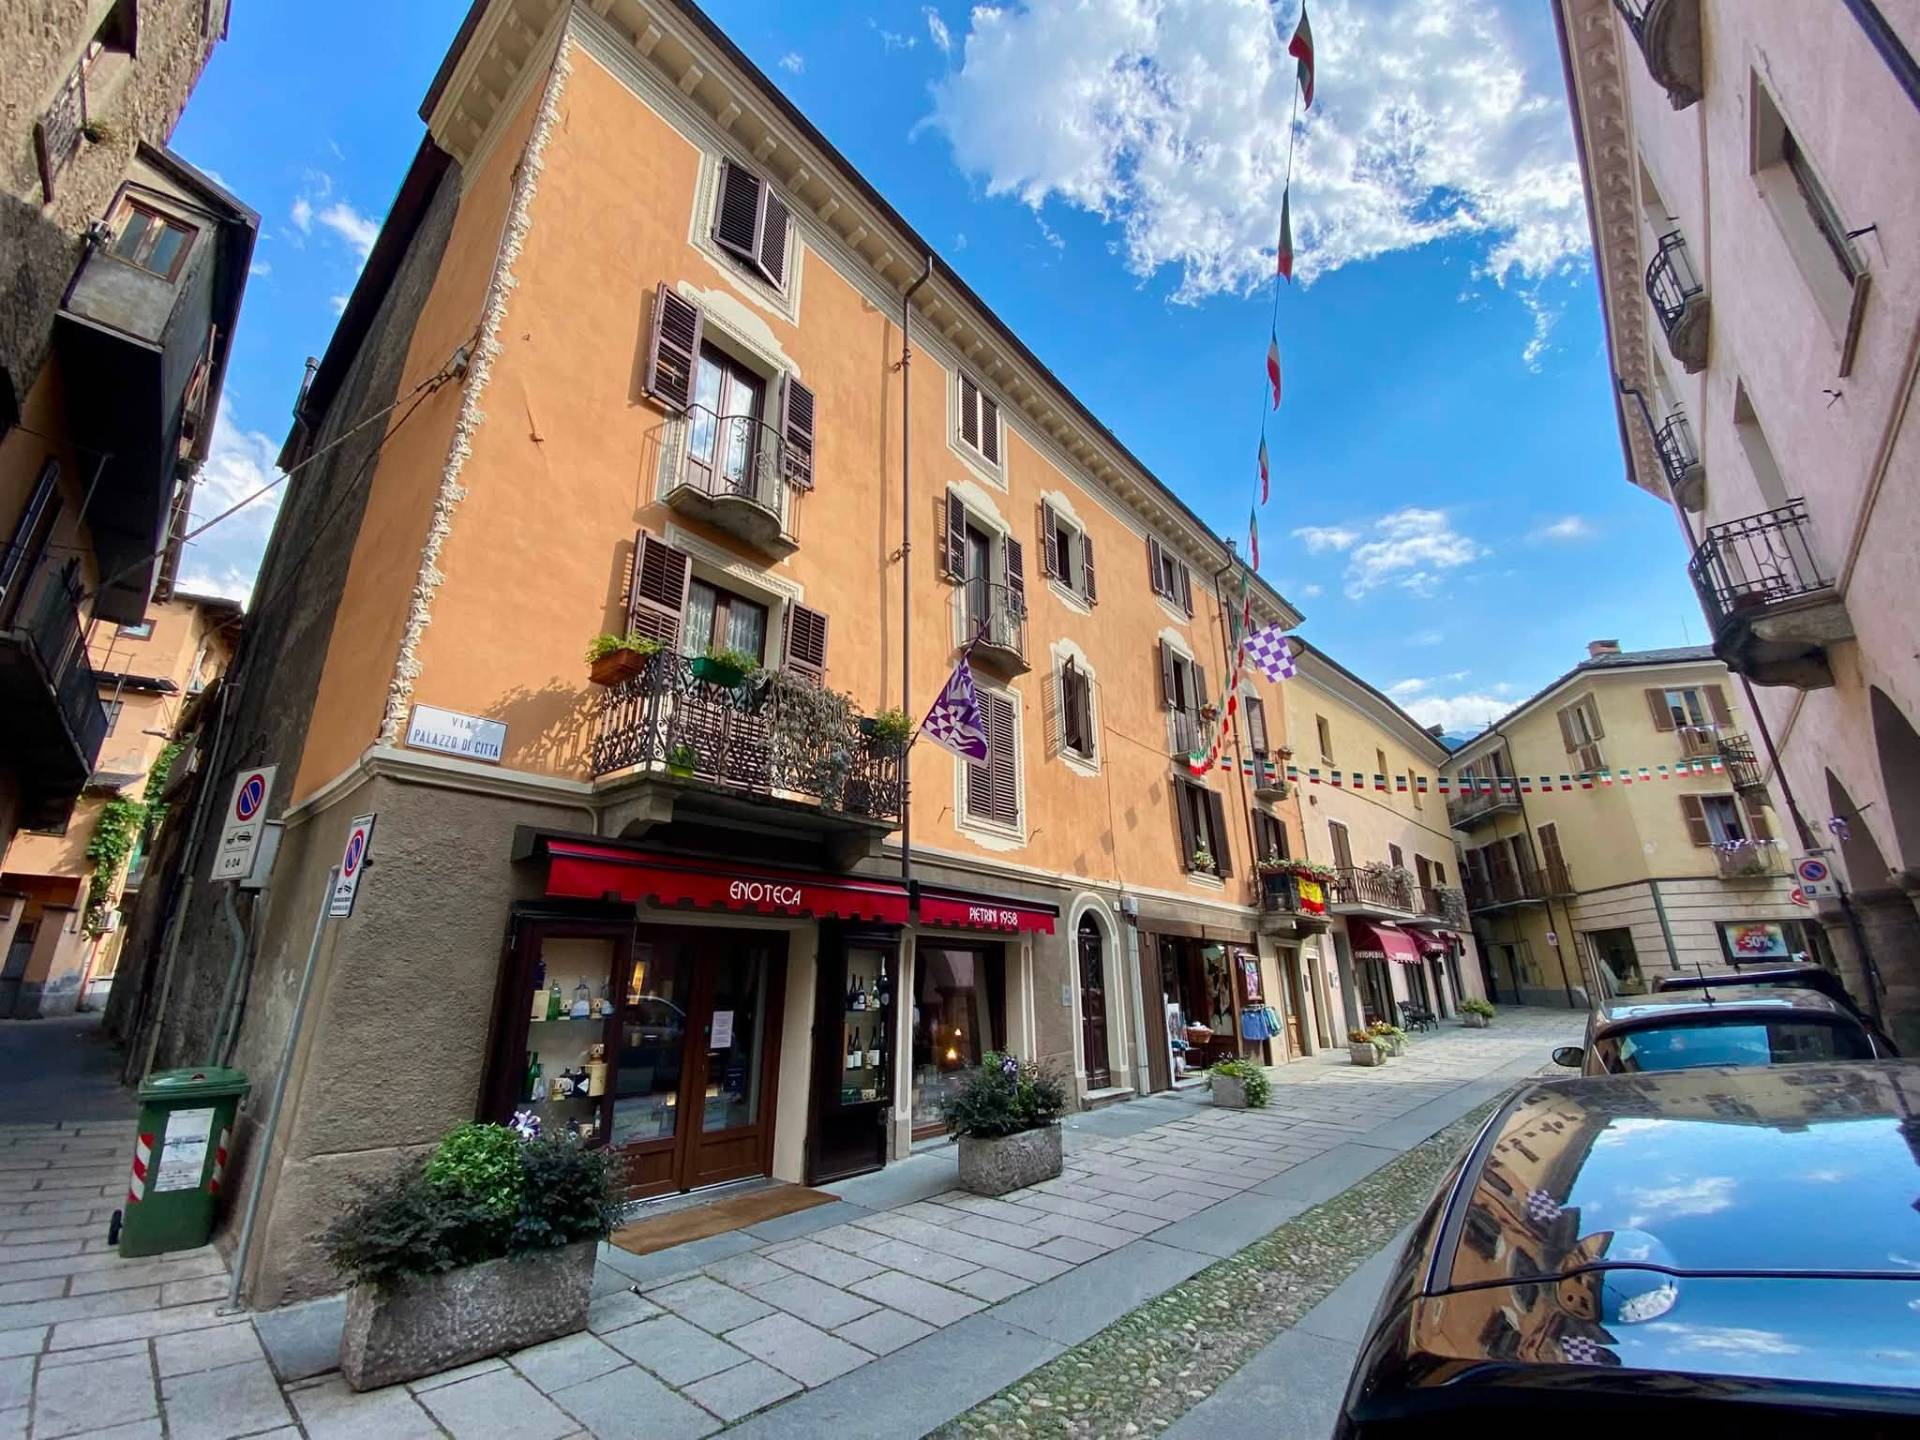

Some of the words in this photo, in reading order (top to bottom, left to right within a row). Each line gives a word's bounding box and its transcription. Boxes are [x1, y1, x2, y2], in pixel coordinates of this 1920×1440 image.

[451, 717, 471, 730] VIA
[414, 729, 458, 749] PALAZZO
[461, 738, 473, 751] DI
[729, 880, 801, 905] ENOTECA
[969, 907, 997, 923] PIETRINI
[1000, 910, 1018, 926] 1958
